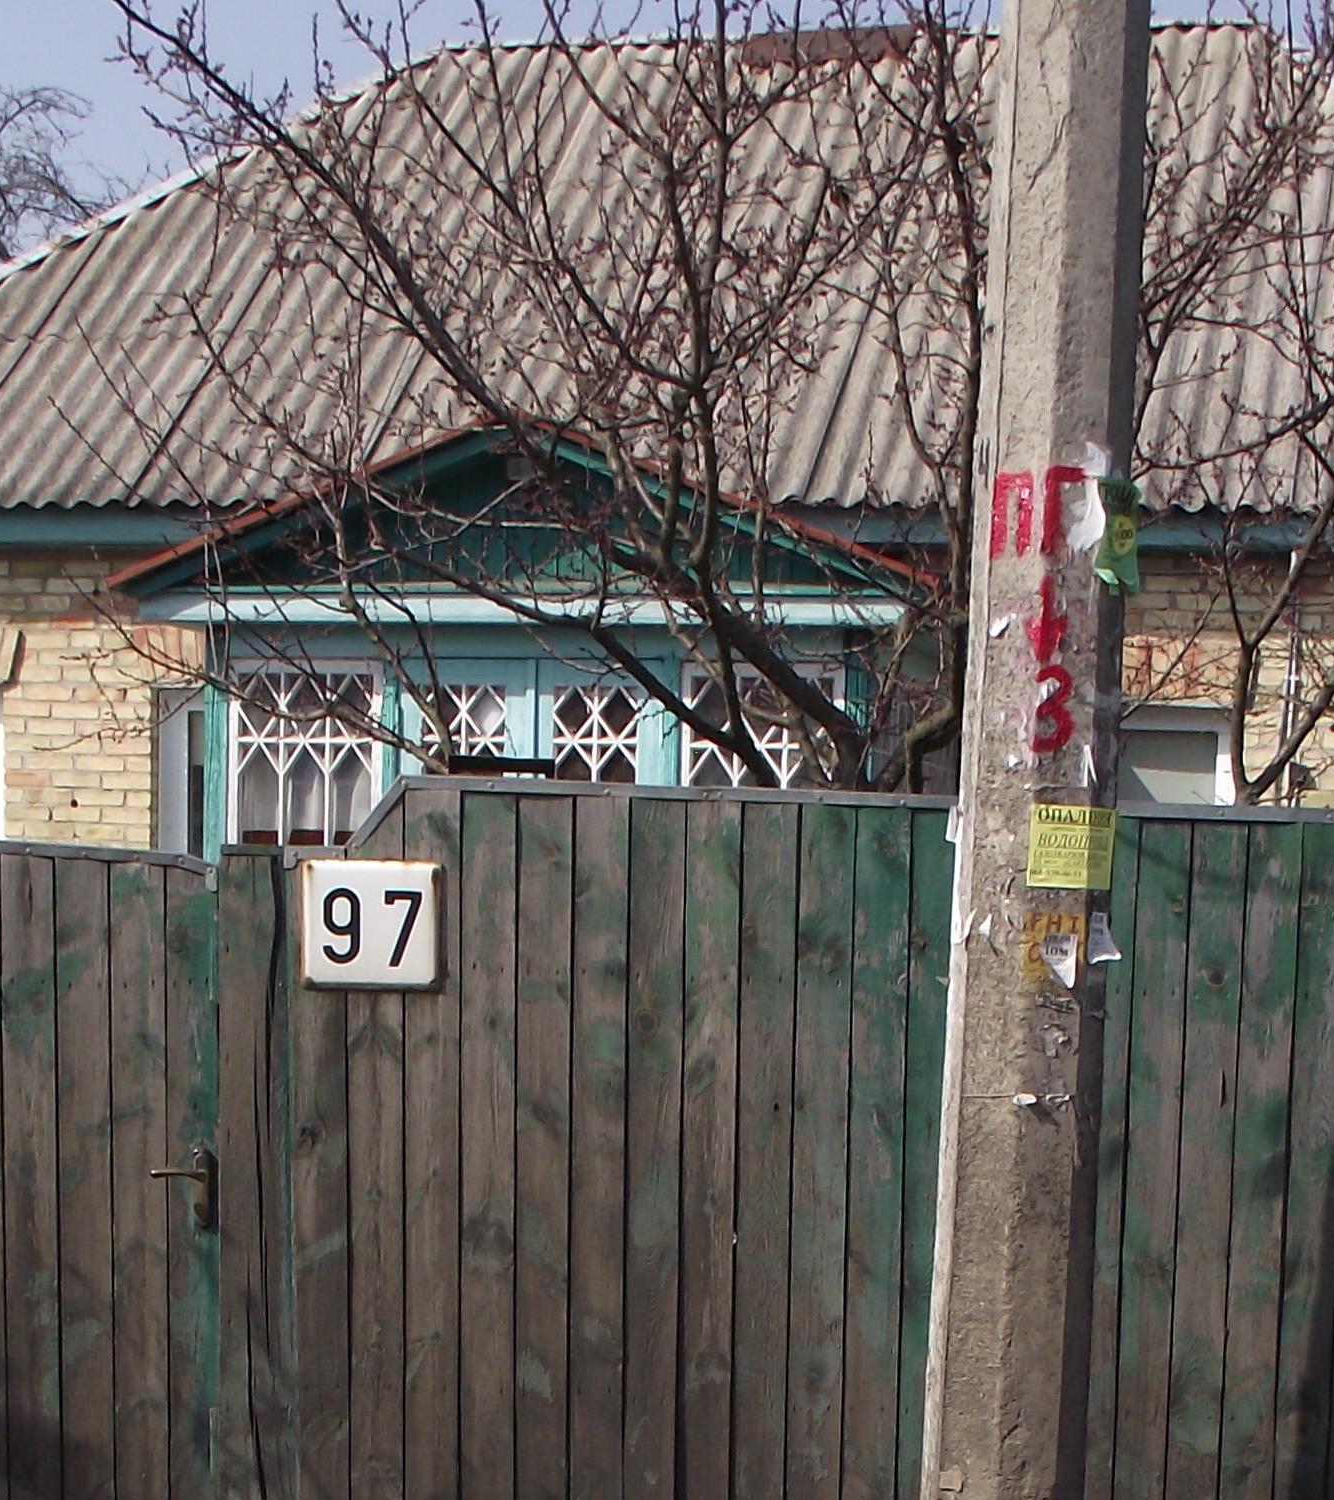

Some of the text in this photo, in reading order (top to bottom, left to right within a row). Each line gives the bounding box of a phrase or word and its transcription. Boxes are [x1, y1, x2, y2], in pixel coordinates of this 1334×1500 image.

[991, 465, 1085, 560] ПГ
[1032, 664, 1076, 753] 3
[322, 887, 423, 968] 97
